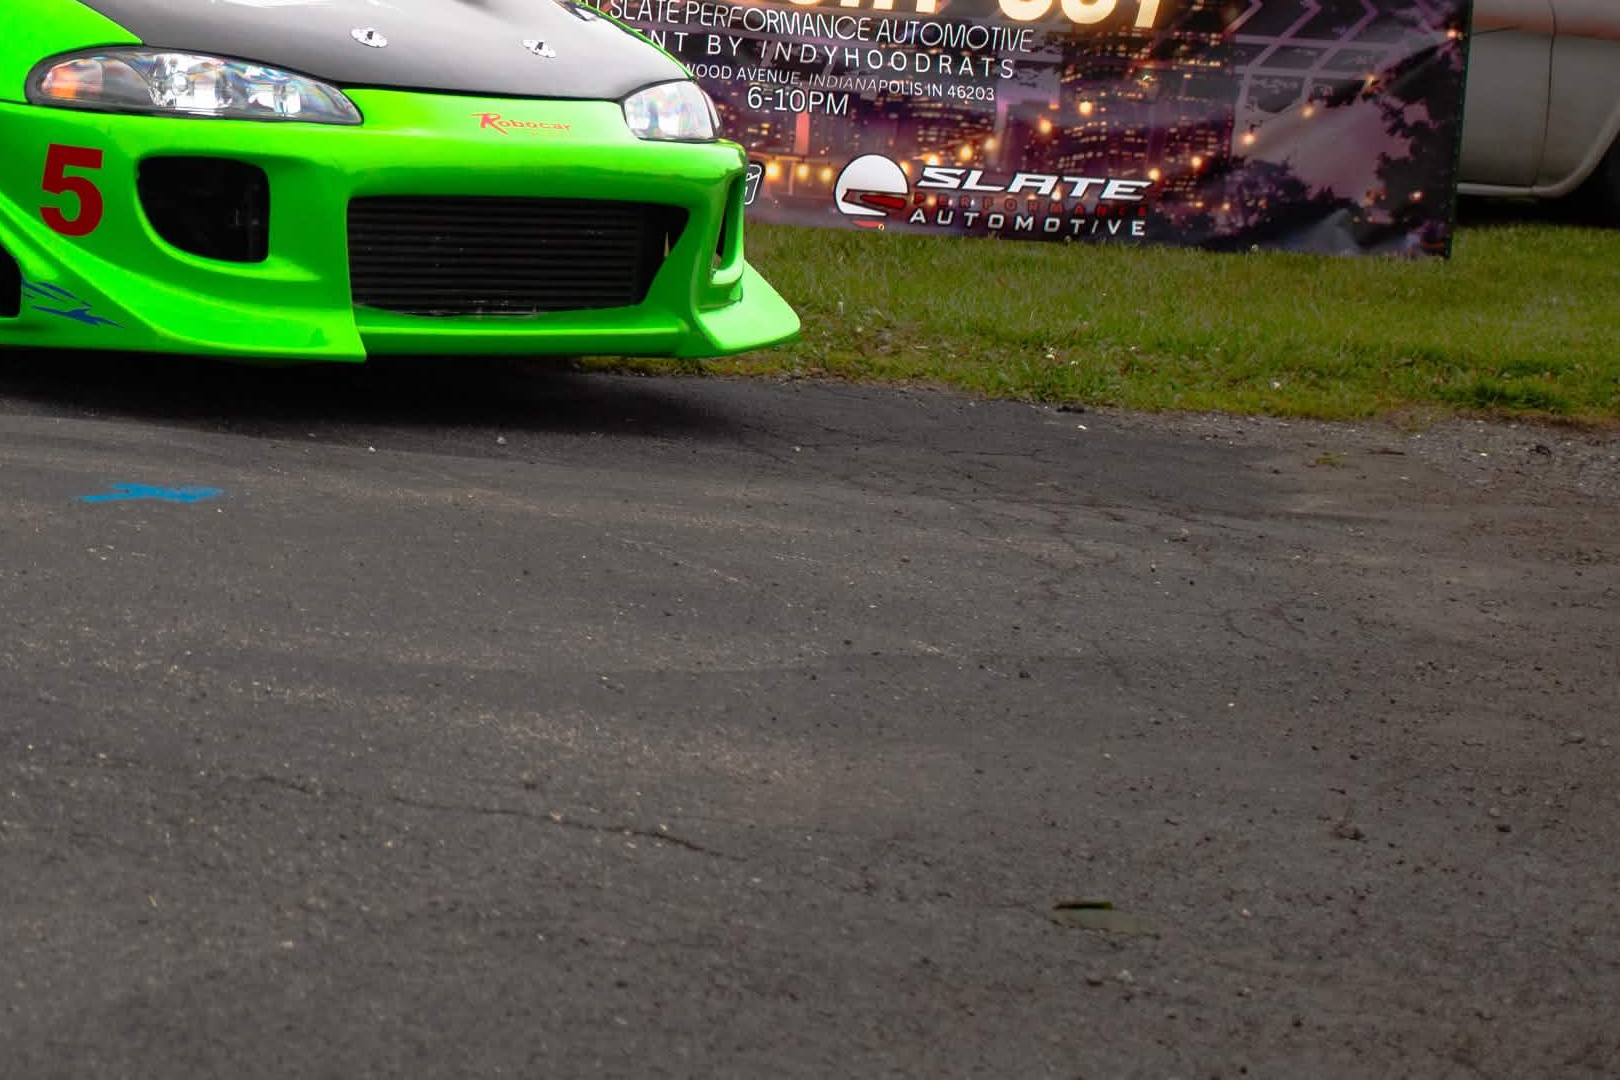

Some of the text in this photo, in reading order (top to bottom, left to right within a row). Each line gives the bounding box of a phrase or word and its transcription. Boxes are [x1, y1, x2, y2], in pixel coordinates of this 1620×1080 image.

[685, 0, 871, 42] PERFORMANCE
[876, 18, 1034, 53] AUTOMOTIVE
[638, 29, 1015, 79] NT BY INDYHOODRATS
[747, 86, 849, 116] 6-10PM
[808, 73, 923, 97] INDIANAPOLIS
[926, 81, 943, 97] IN
[947, 85, 995, 101] 46203
[470, 112, 570, 135] Robocar
[39, 142, 104, 237] 5
[916, 166, 1154, 201] SLATE
[908, 207, 1146, 236] AUTOMOTIVE
